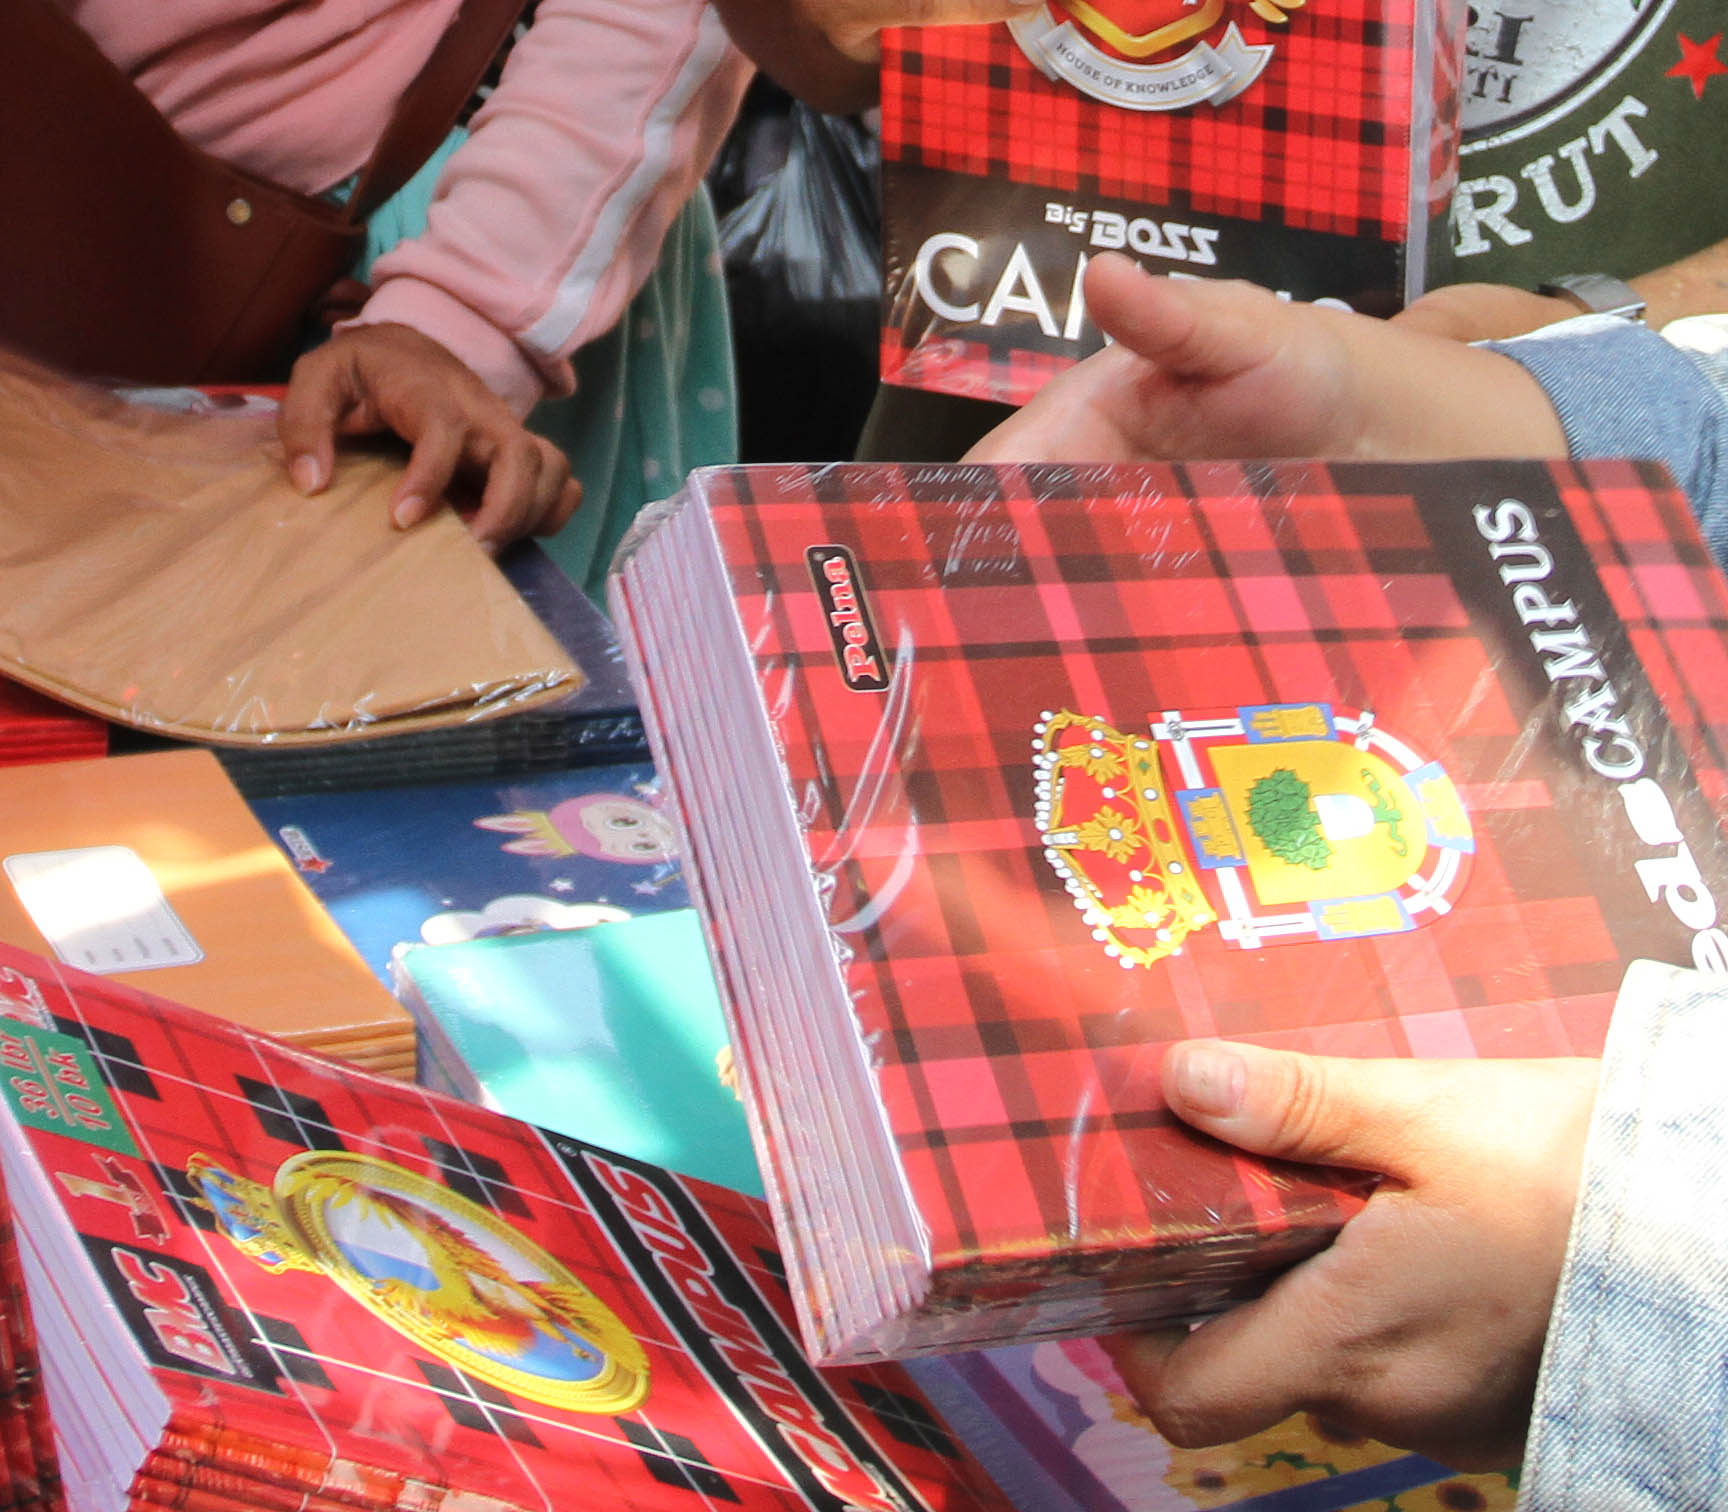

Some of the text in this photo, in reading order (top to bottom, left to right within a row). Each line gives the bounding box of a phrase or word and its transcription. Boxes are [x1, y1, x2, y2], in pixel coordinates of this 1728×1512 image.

[1055, 42, 1215, 95] HOUSE OF KNOWLEDGE
[1089, 209, 1220, 266] BOSS
[1472, 497, 1646, 780] CAMPUS
[10, 1076, 60, 1119] 36
[65, 1092, 113, 1130] 10
